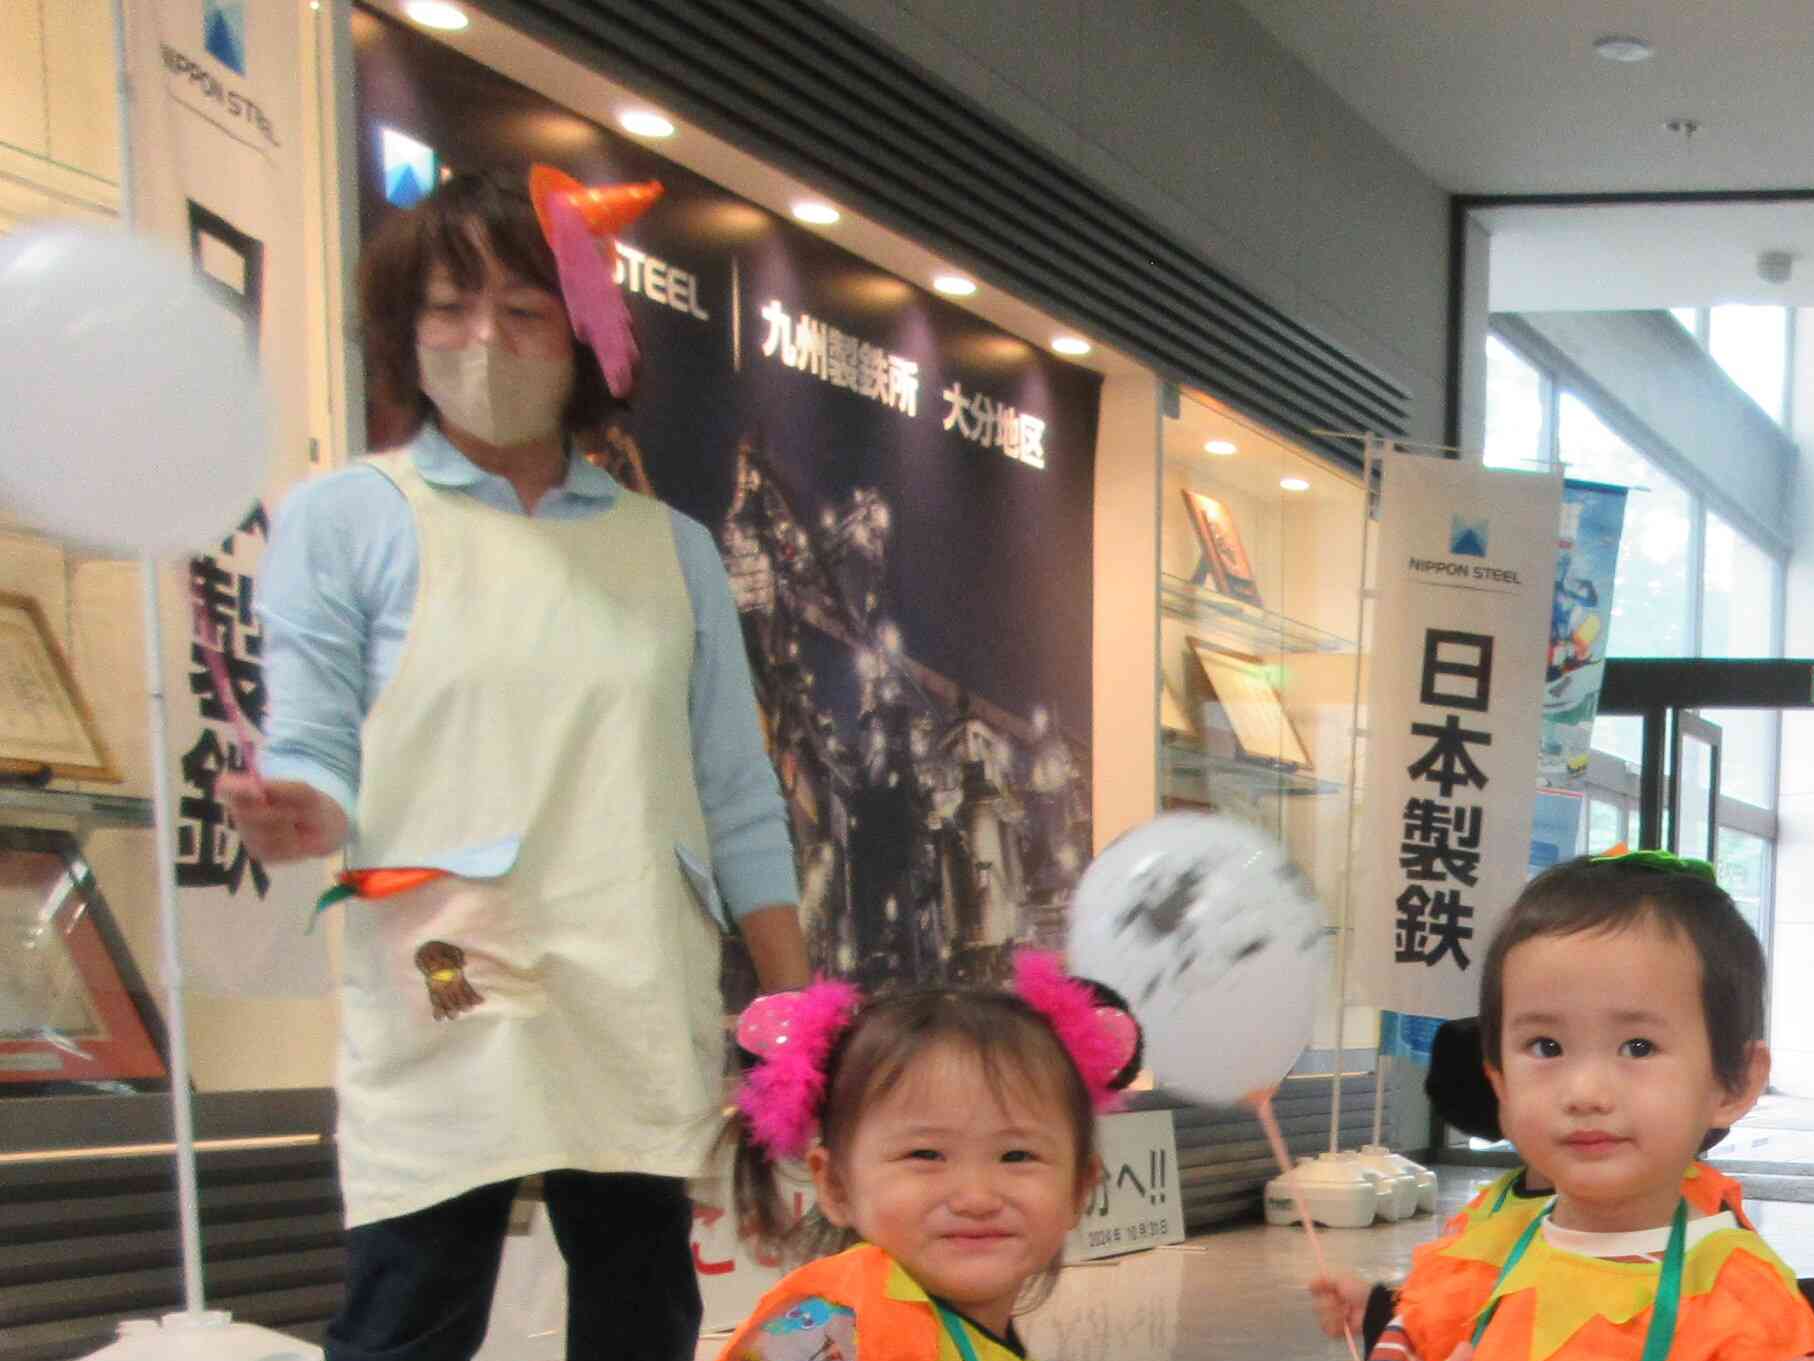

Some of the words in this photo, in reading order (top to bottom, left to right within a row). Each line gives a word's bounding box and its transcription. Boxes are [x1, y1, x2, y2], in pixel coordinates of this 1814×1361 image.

[761, 301, 919, 417] 九州製鉄所
[943, 384, 1046, 468] 大分地区
[1409, 557, 1469, 577] NIPPON
[1472, 566, 1521, 584] STEEL
[1395, 628, 1494, 971] 日本製鉄
